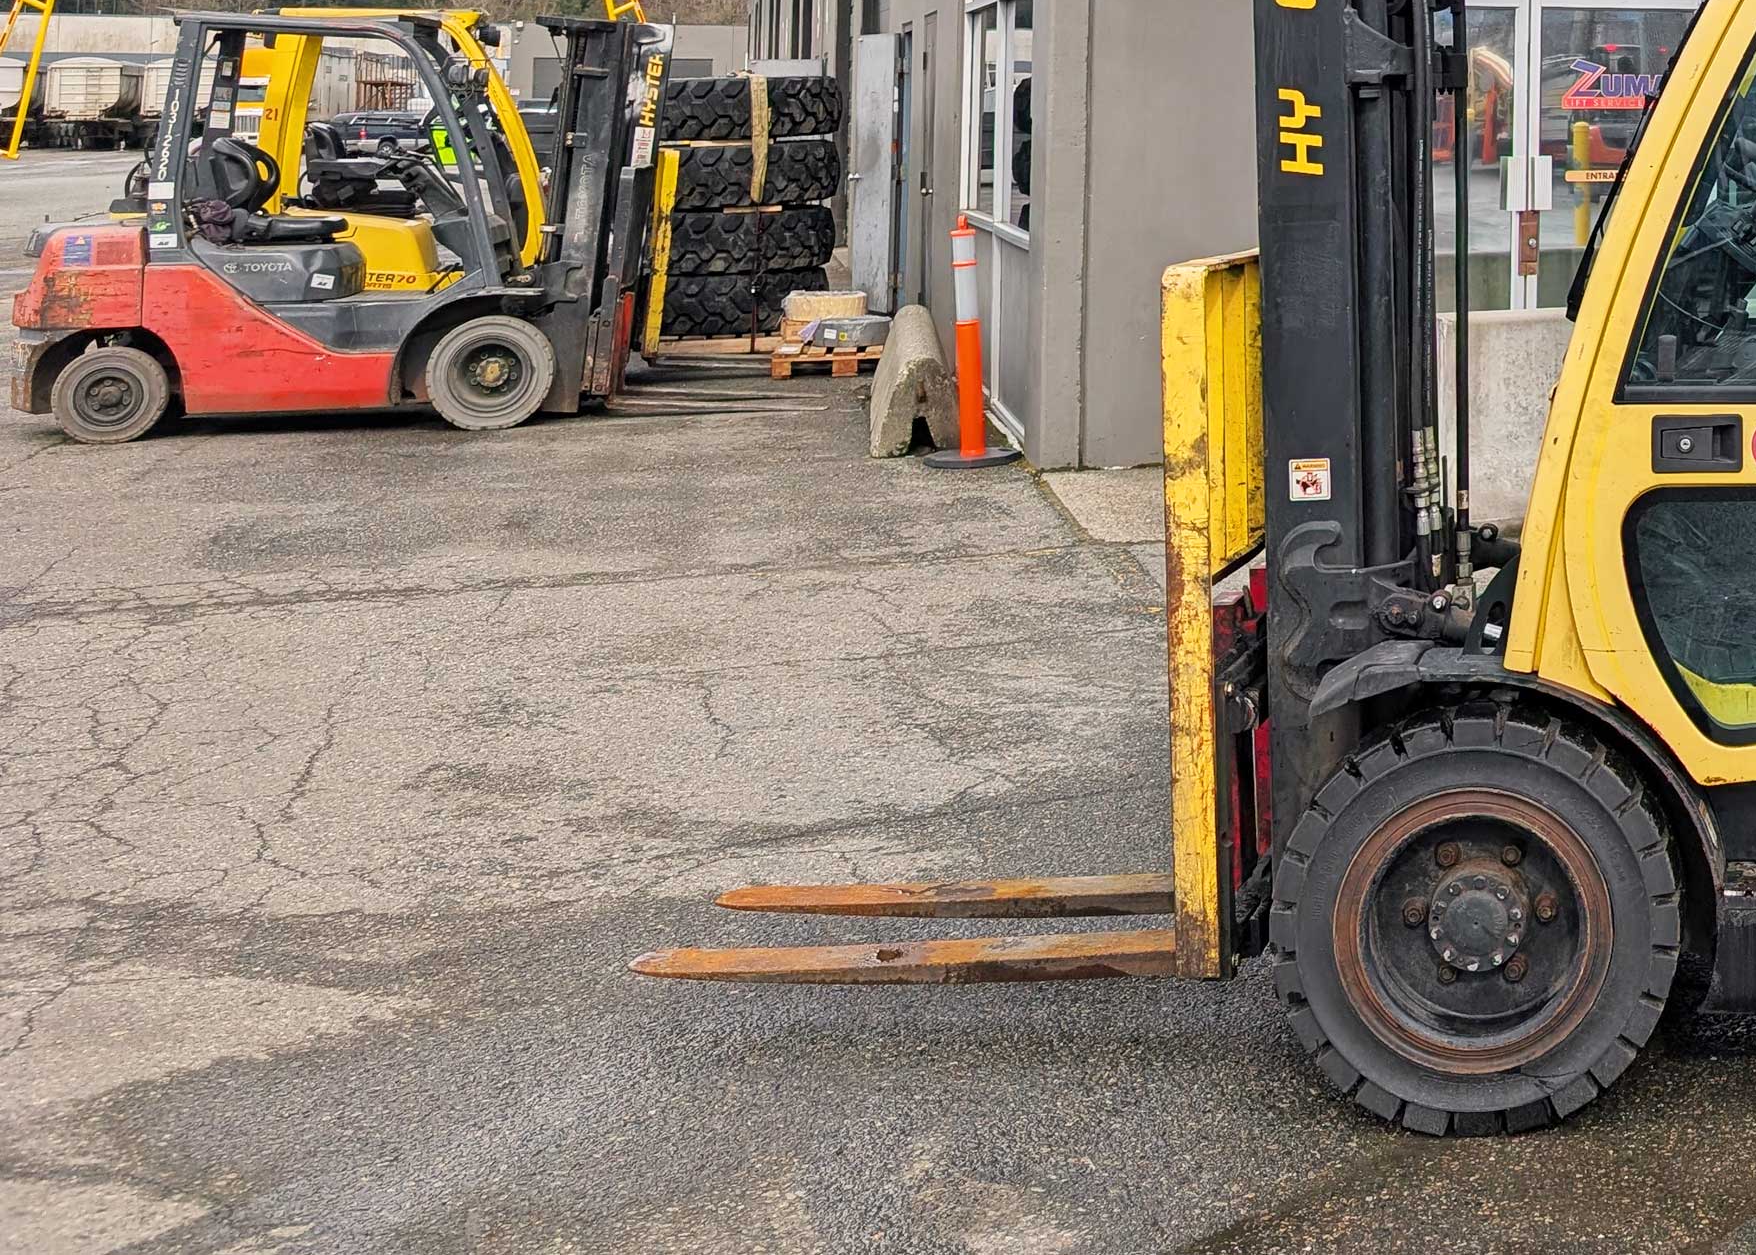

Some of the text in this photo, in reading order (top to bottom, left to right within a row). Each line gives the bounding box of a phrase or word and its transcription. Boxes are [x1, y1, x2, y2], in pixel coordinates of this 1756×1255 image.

[639, 53, 665, 126] HYSTER
[1564, 97, 1587, 107] LIFT
[265, 108, 278, 121] 21
[158, 89, 181, 181] 10312620
[1585, 171, 1617, 180] ENTRA
[243, 261, 293, 272] TOYOTA
[396, 274, 416, 284] 70
